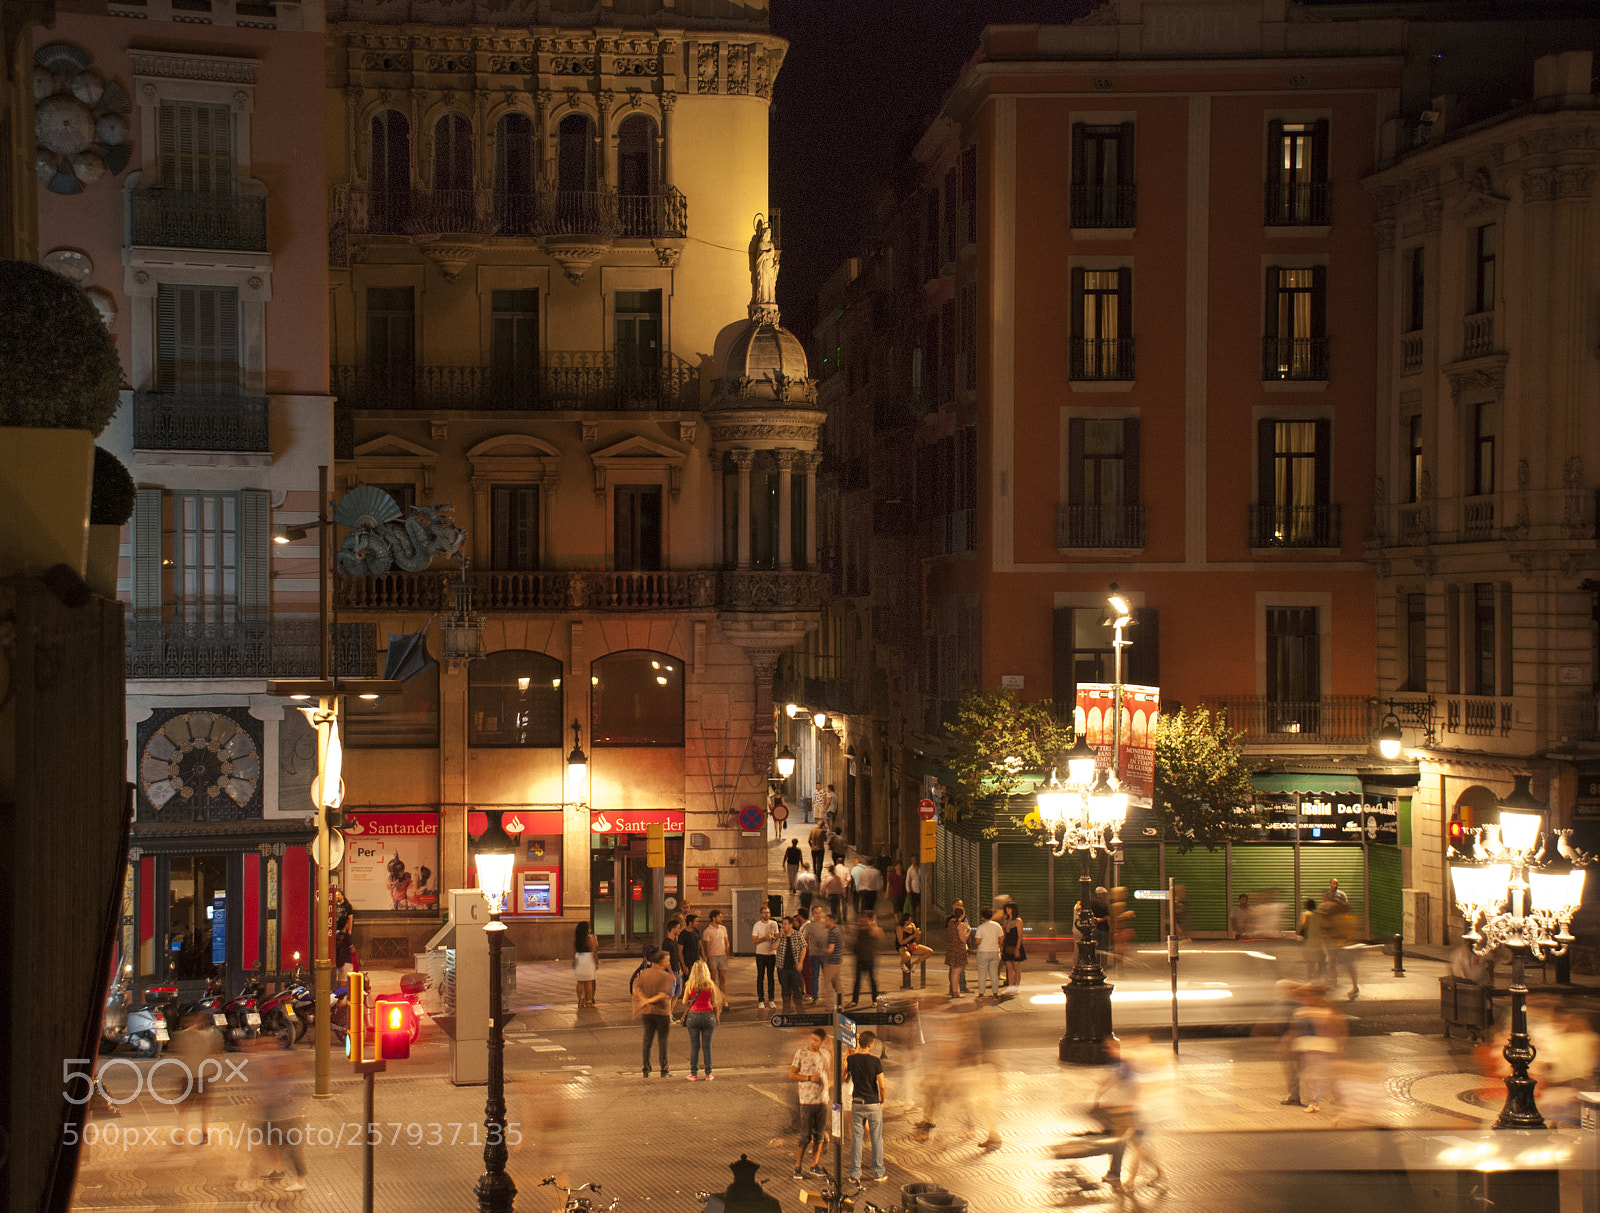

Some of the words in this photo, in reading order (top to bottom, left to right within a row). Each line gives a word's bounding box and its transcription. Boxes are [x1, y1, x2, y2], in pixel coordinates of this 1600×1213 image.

[1338, 804, 1362, 814] D&G
[369, 820, 438, 834] Santander
[616, 817, 684, 832] Santder
[357, 847, 376, 857] Per
